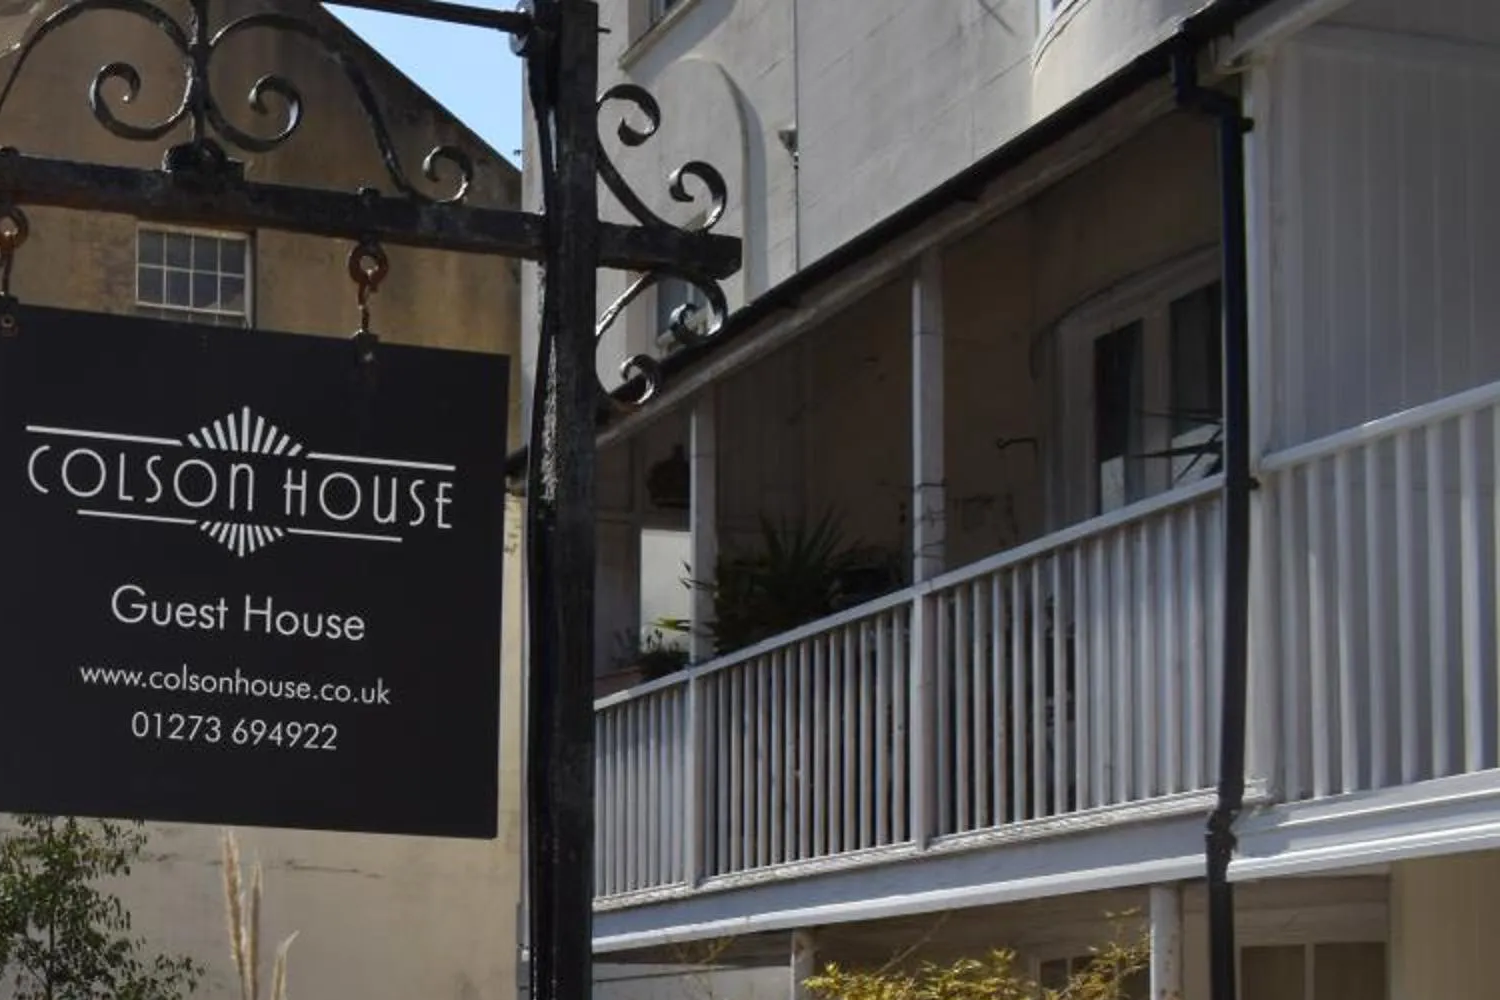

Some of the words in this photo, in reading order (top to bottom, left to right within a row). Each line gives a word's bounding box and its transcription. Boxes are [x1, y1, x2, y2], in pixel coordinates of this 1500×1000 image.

[283, 468, 453, 529] HOUSE
[111, 584, 229, 630] Guest
[244, 594, 365, 641] House
[80, 664, 390, 705] www.colsonhouse.co.uk
[131, 711, 221, 743] 01273
[231, 718, 338, 750] 694922
